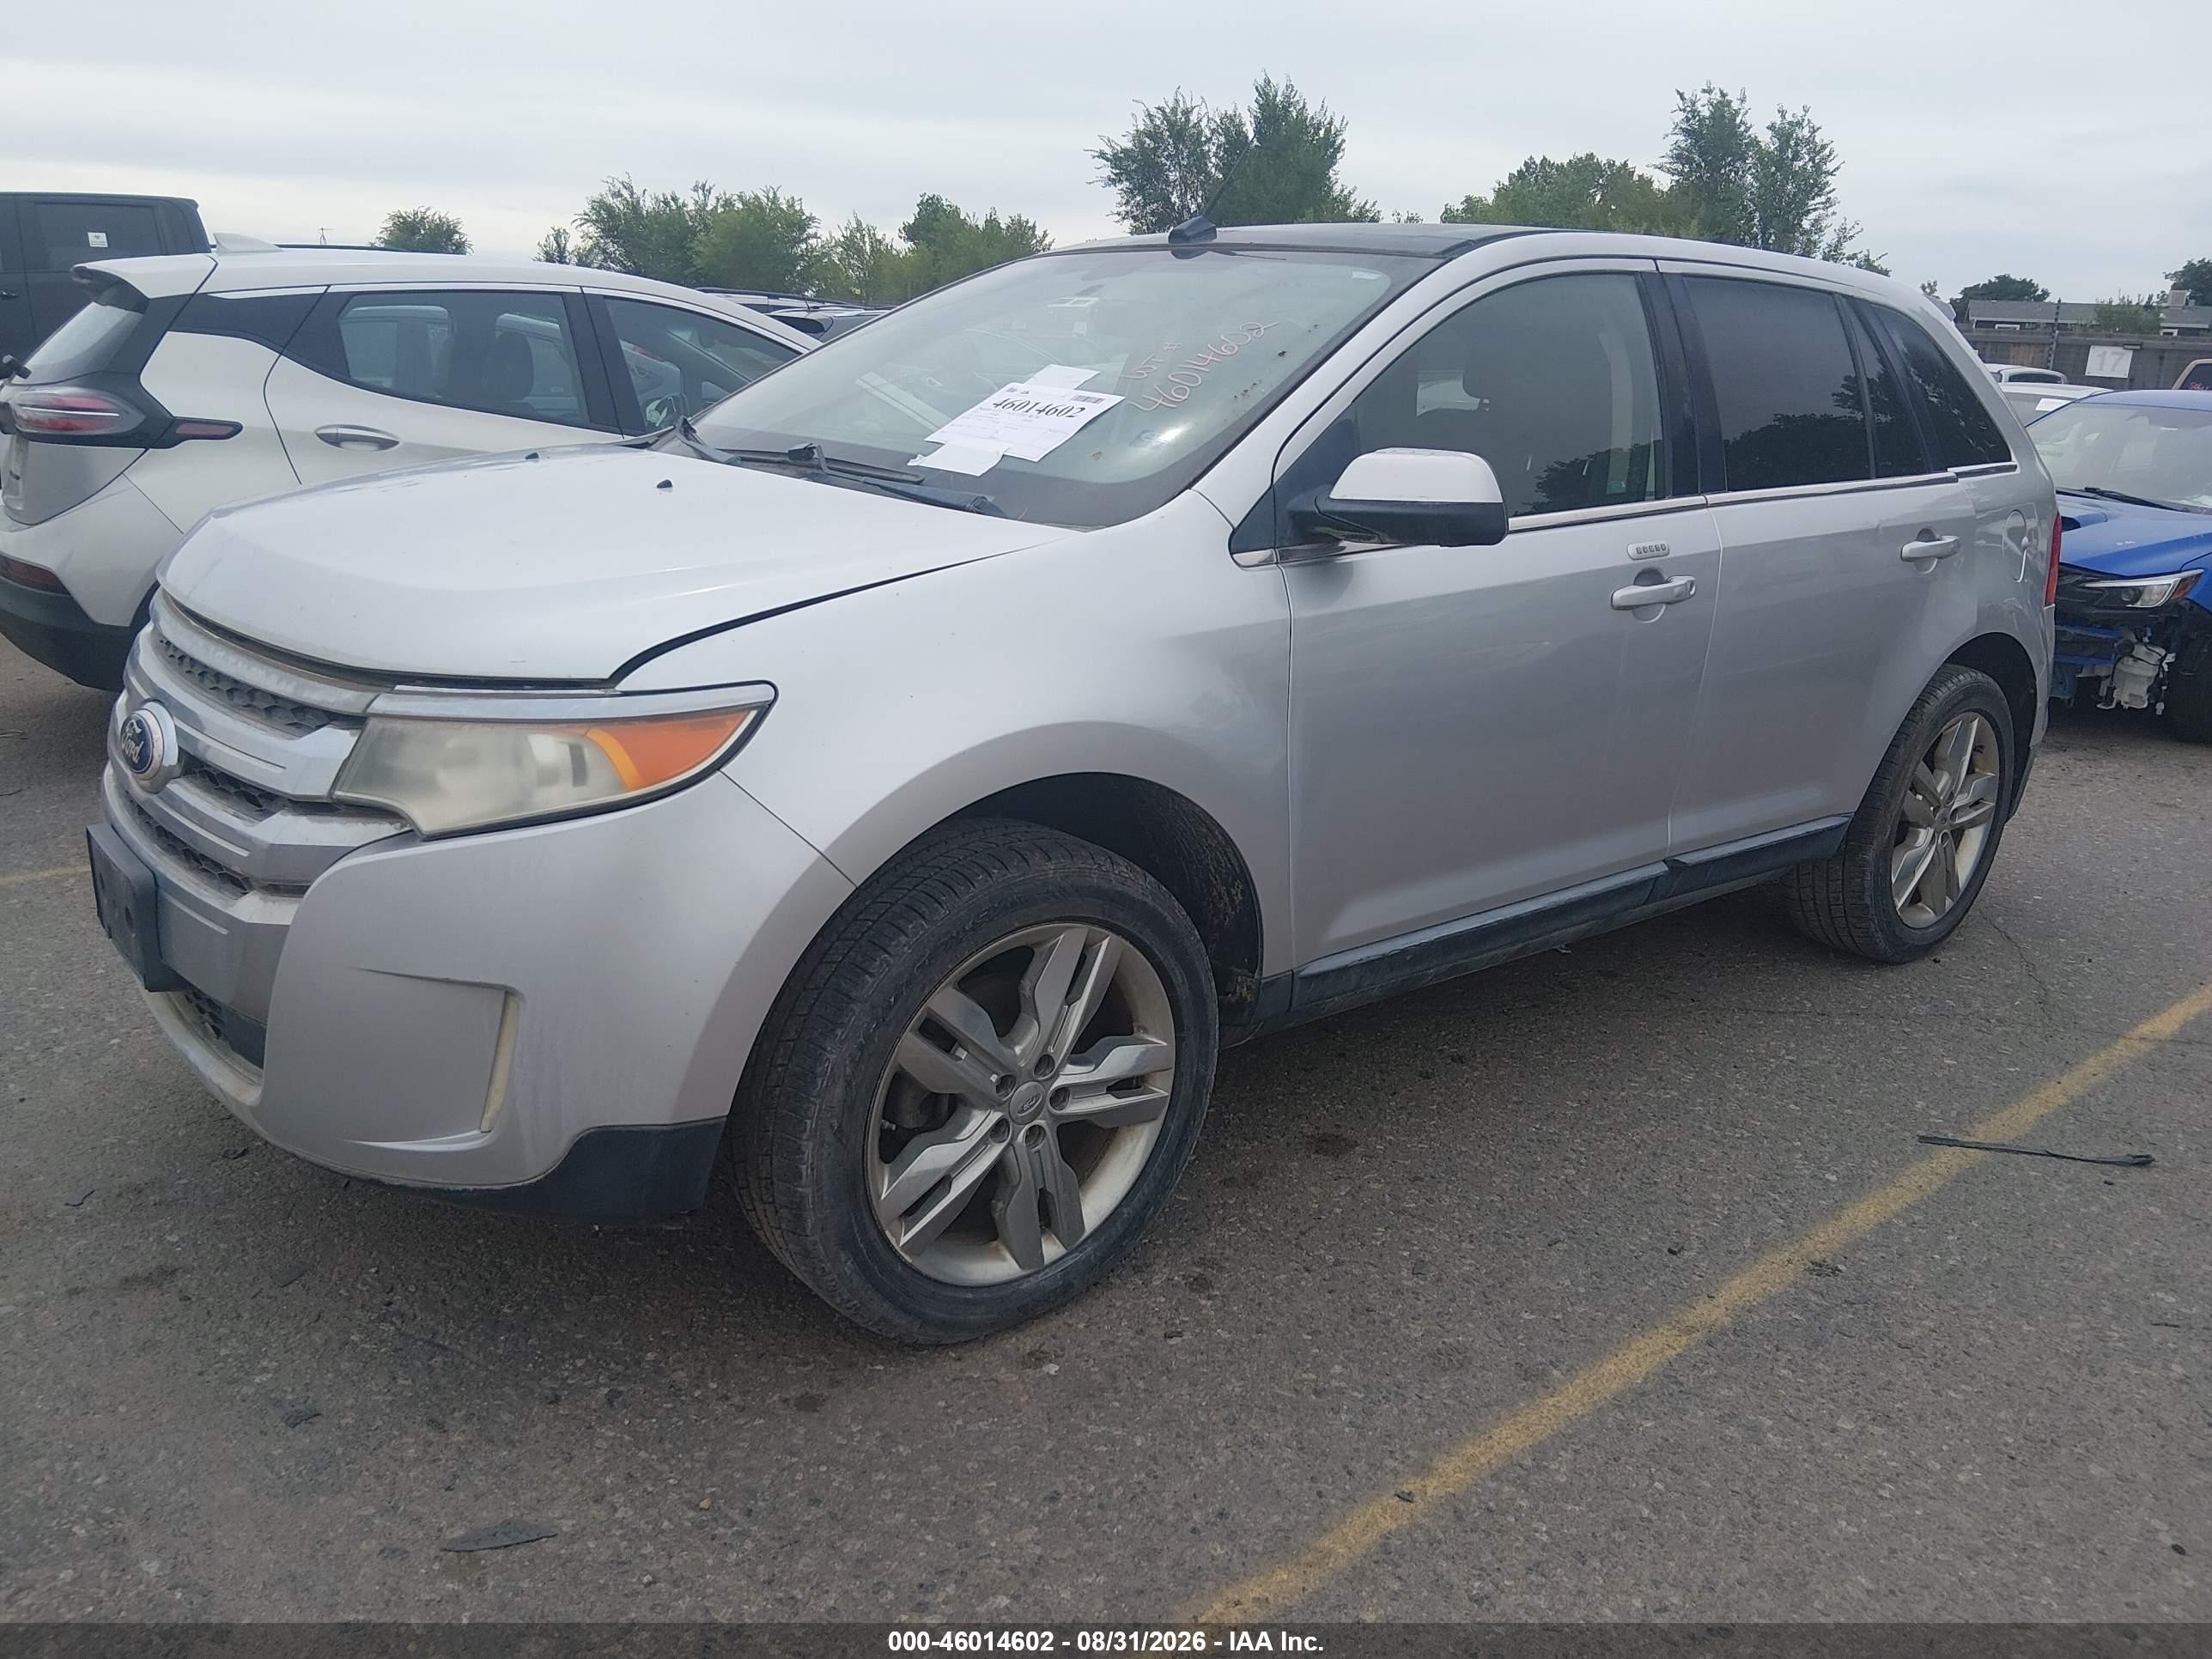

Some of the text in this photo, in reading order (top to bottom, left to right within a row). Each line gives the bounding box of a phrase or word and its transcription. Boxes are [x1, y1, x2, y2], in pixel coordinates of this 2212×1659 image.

[1127, 320, 1280, 412] 46014602
[2096, 349, 2127, 373] 17
[992, 397, 1087, 418] 46014602
[121, 718, 144, 763] Ford
